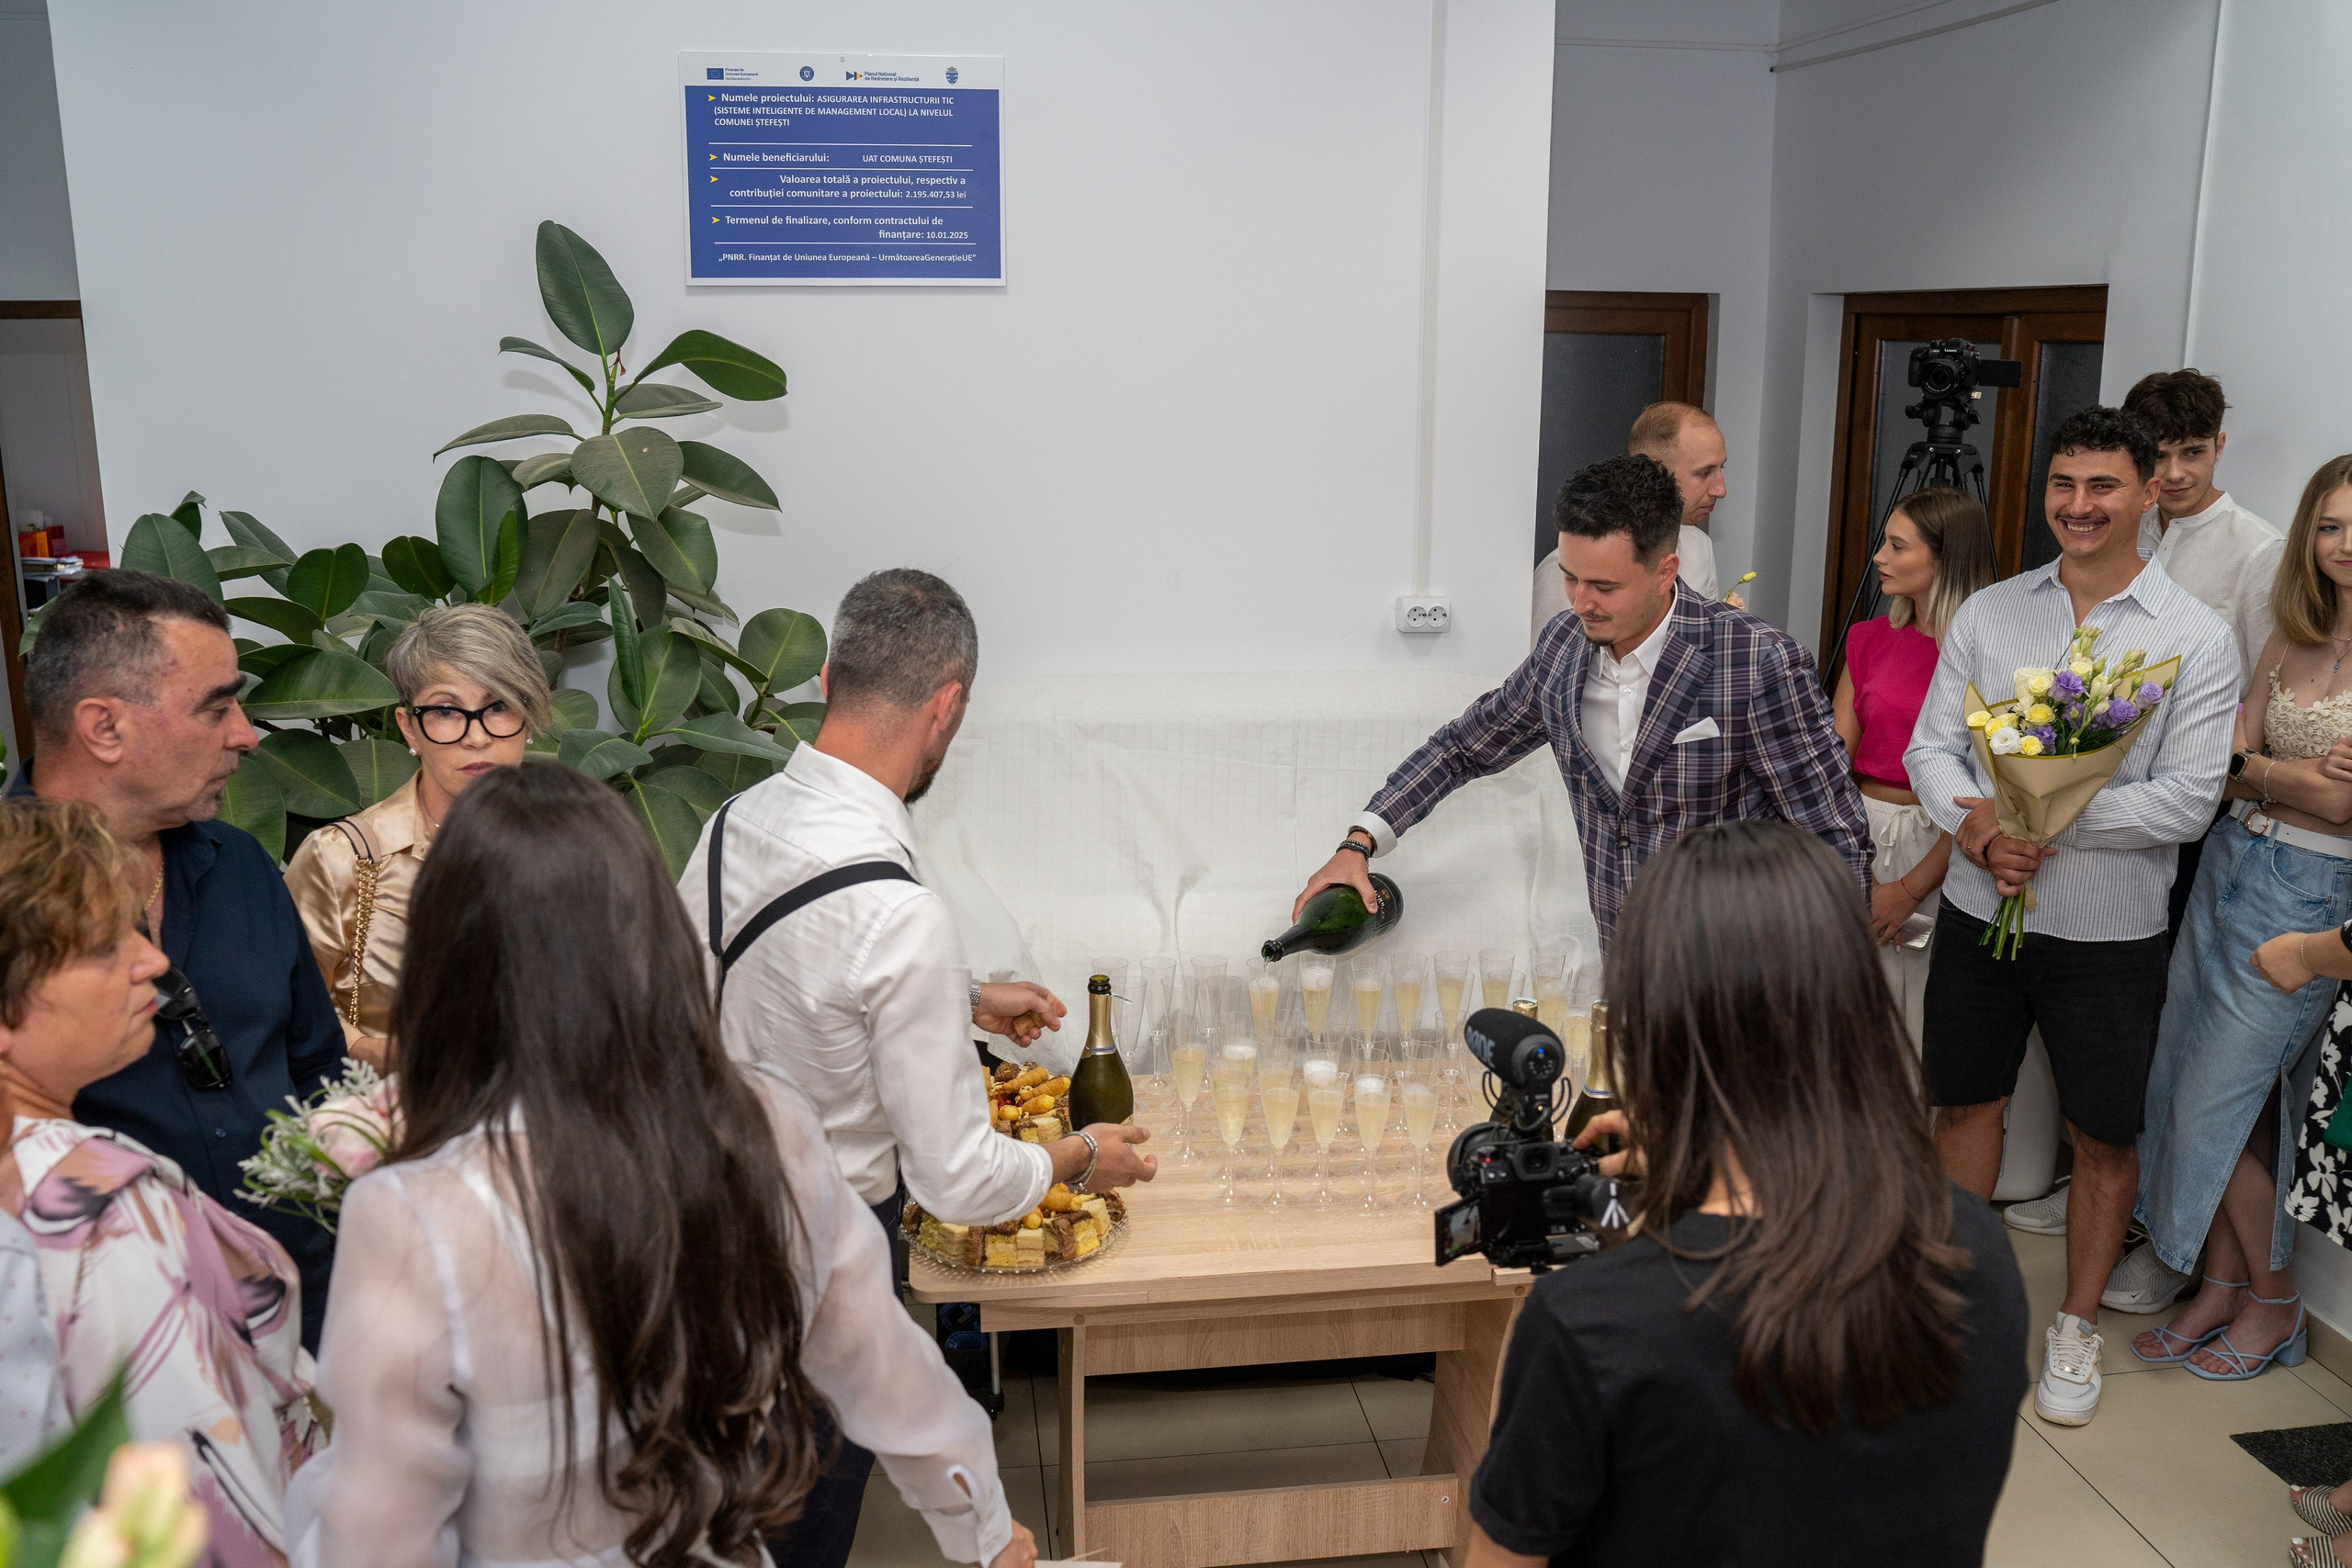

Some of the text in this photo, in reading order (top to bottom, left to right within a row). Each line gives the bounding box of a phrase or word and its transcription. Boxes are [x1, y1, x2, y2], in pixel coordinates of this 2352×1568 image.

[721, 93, 955, 105] Numele proiectului: ASIGURAREA INFRASTRUCTURII TIC
[714, 106, 751, 116] (SISTEME
[752, 107, 803, 115] INTELIGENTE
[818, 107, 876, 116] MANAGEMENT
[879, 108, 907, 118] LOCAL)
[921, 108, 954, 117] NIVELUL
[714, 118, 753, 126] COMUNEI
[723, 152, 760, 162] Numele
[762, 152, 830, 162] beneficiarului:
[862, 154, 878, 163] UAT
[879, 154, 917, 164] COMUNA
[779, 174, 820, 184] Valoarea
[822, 175, 851, 184] totală
[861, 175, 914, 186] proiectului,
[916, 175, 958, 186] respectiv
[786, 187, 840, 197] comunitare
[850, 188, 903, 199] proiectului:
[905, 190, 956, 199] 2.195.407,53
[956, 190, 967, 198] lei
[725, 215, 944, 226] Termenul de finalizare, conform contractului de
[782, 254, 793, 262] de
[794, 254, 827, 262] Uniunea
[829, 254, 870, 263] Europeană
